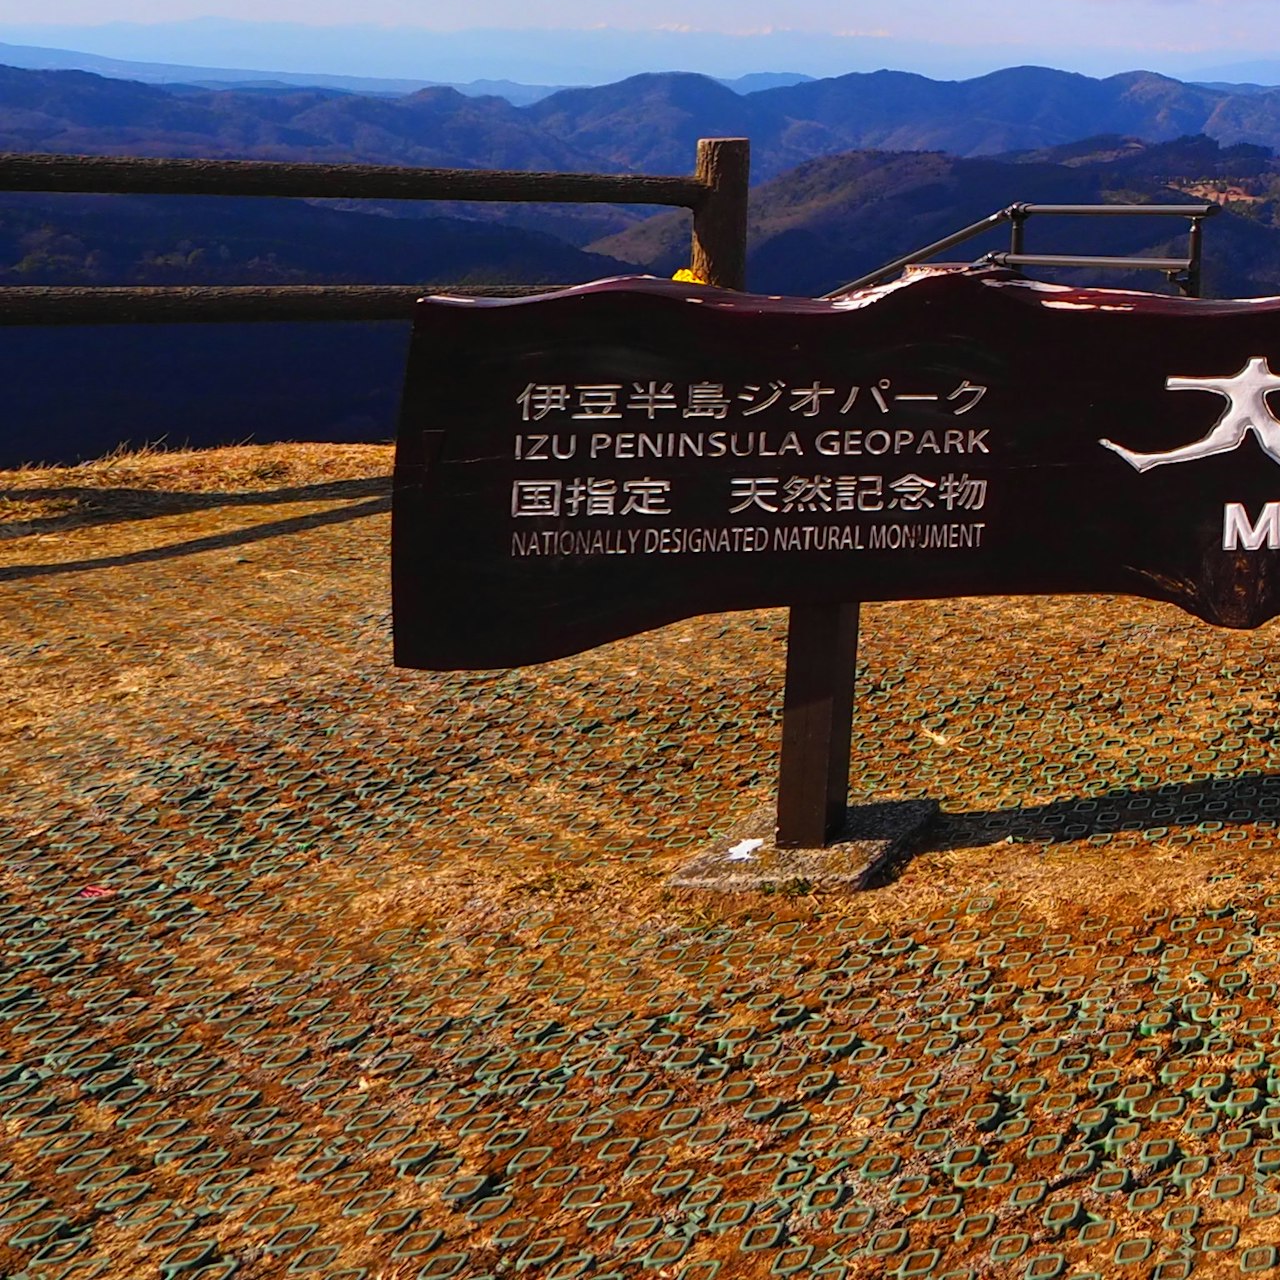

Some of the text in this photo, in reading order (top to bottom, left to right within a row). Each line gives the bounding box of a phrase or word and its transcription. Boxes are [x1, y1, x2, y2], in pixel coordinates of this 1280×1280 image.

[516, 378, 988, 421] 伊豆半島ジオパーク
[515, 429, 990, 461] IZU PENINSULA GEOPARK
[511, 473, 988, 518] 国指定 天然記念物
[511, 523, 986, 556] NATIONALLY DESIGNATED NATURAL MONUMENT
